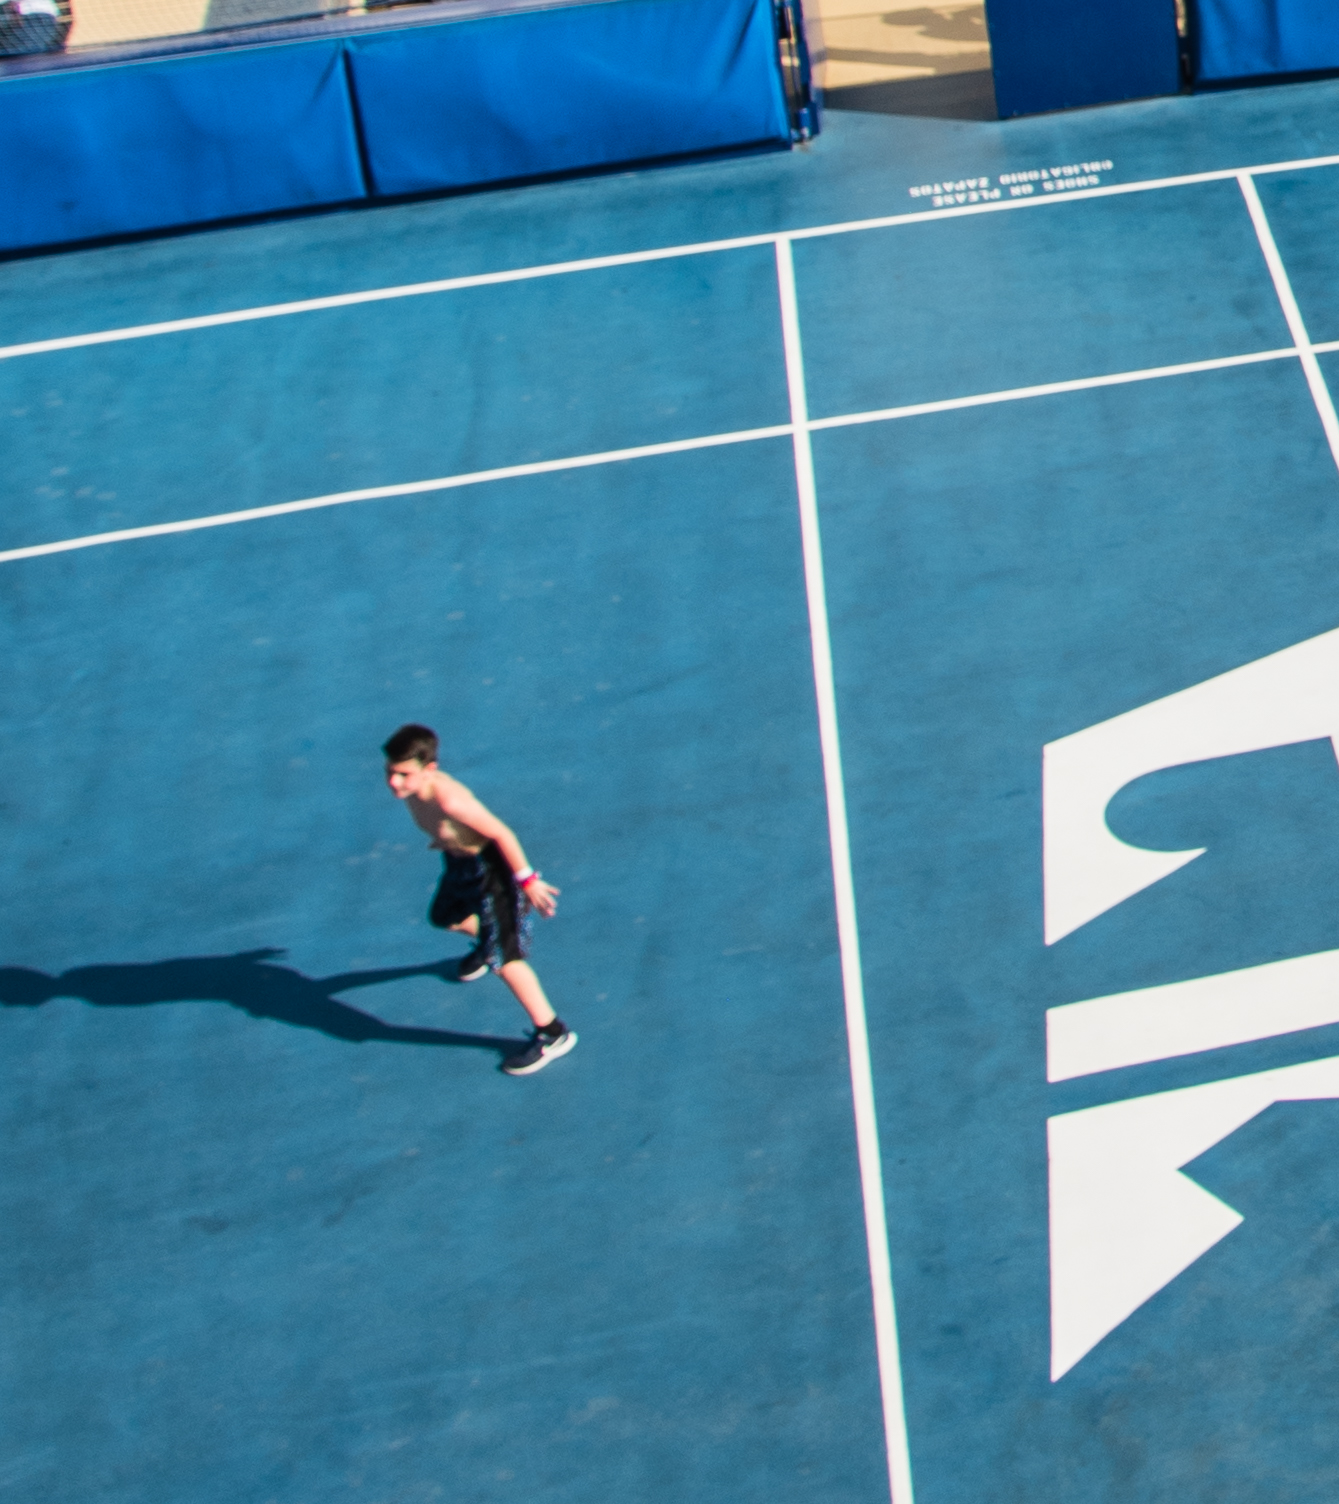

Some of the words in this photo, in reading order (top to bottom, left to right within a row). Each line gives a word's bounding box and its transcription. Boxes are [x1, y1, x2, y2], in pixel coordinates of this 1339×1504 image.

[999, 159, 1114, 186] OBLIGATORIO
[908, 176, 990, 199] ZAPATOS
[1010, 184, 1035, 197] ON
[1042, 175, 1100, 191] SHOES
[932, 189, 1002, 207] PLEASE
